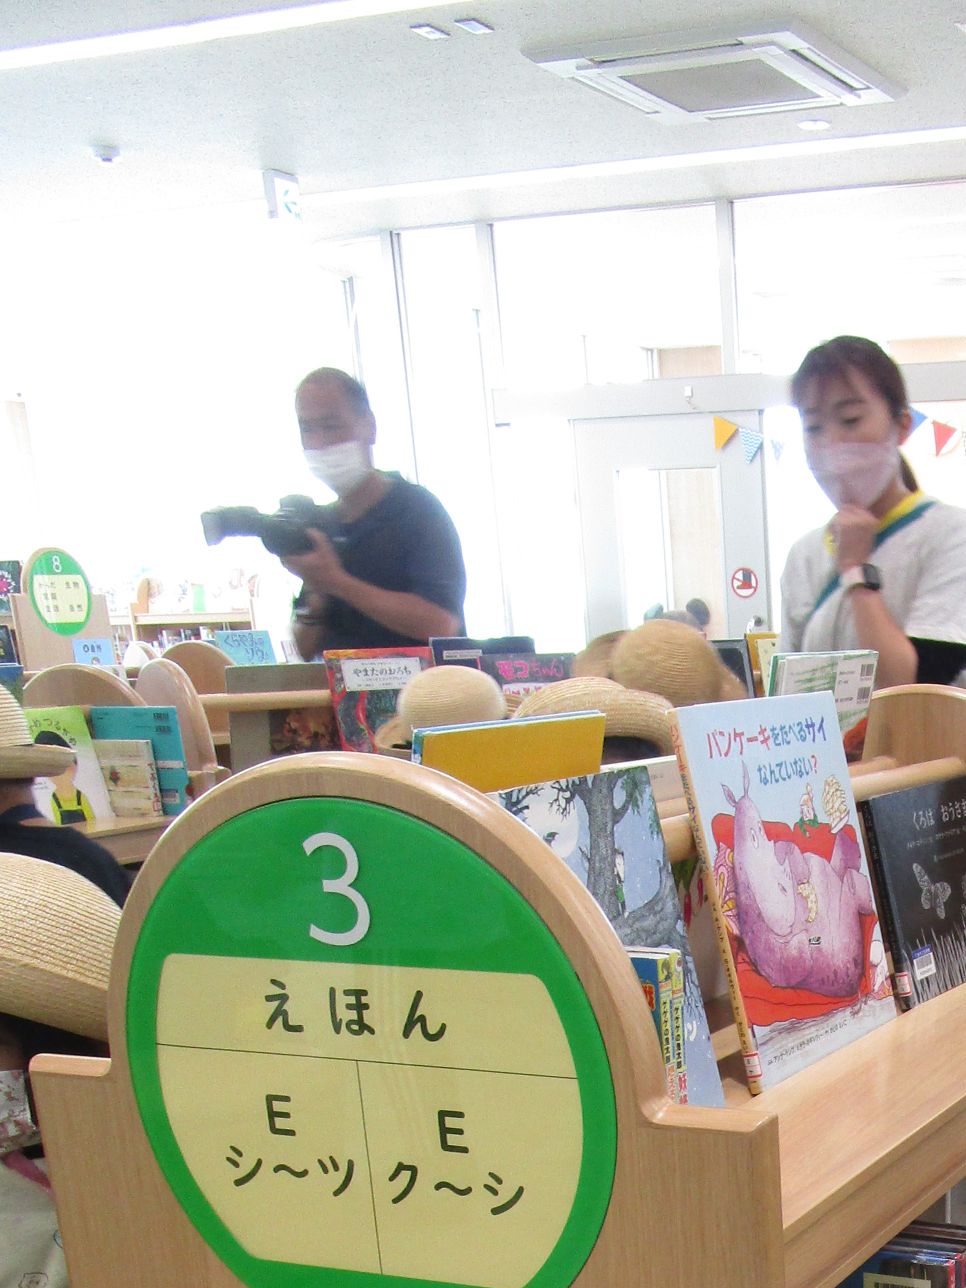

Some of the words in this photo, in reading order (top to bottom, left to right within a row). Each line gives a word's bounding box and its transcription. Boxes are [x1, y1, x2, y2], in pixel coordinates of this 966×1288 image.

[52, 555, 62, 573] 8
[352, 665, 412, 677] やまたのおろち
[756, 754, 818, 786] なんていない?
[302, 832, 371, 946] 3
[264, 978, 447, 1043] えほん
[265, 1093, 297, 1137] E
[437, 1109, 470, 1154] E
